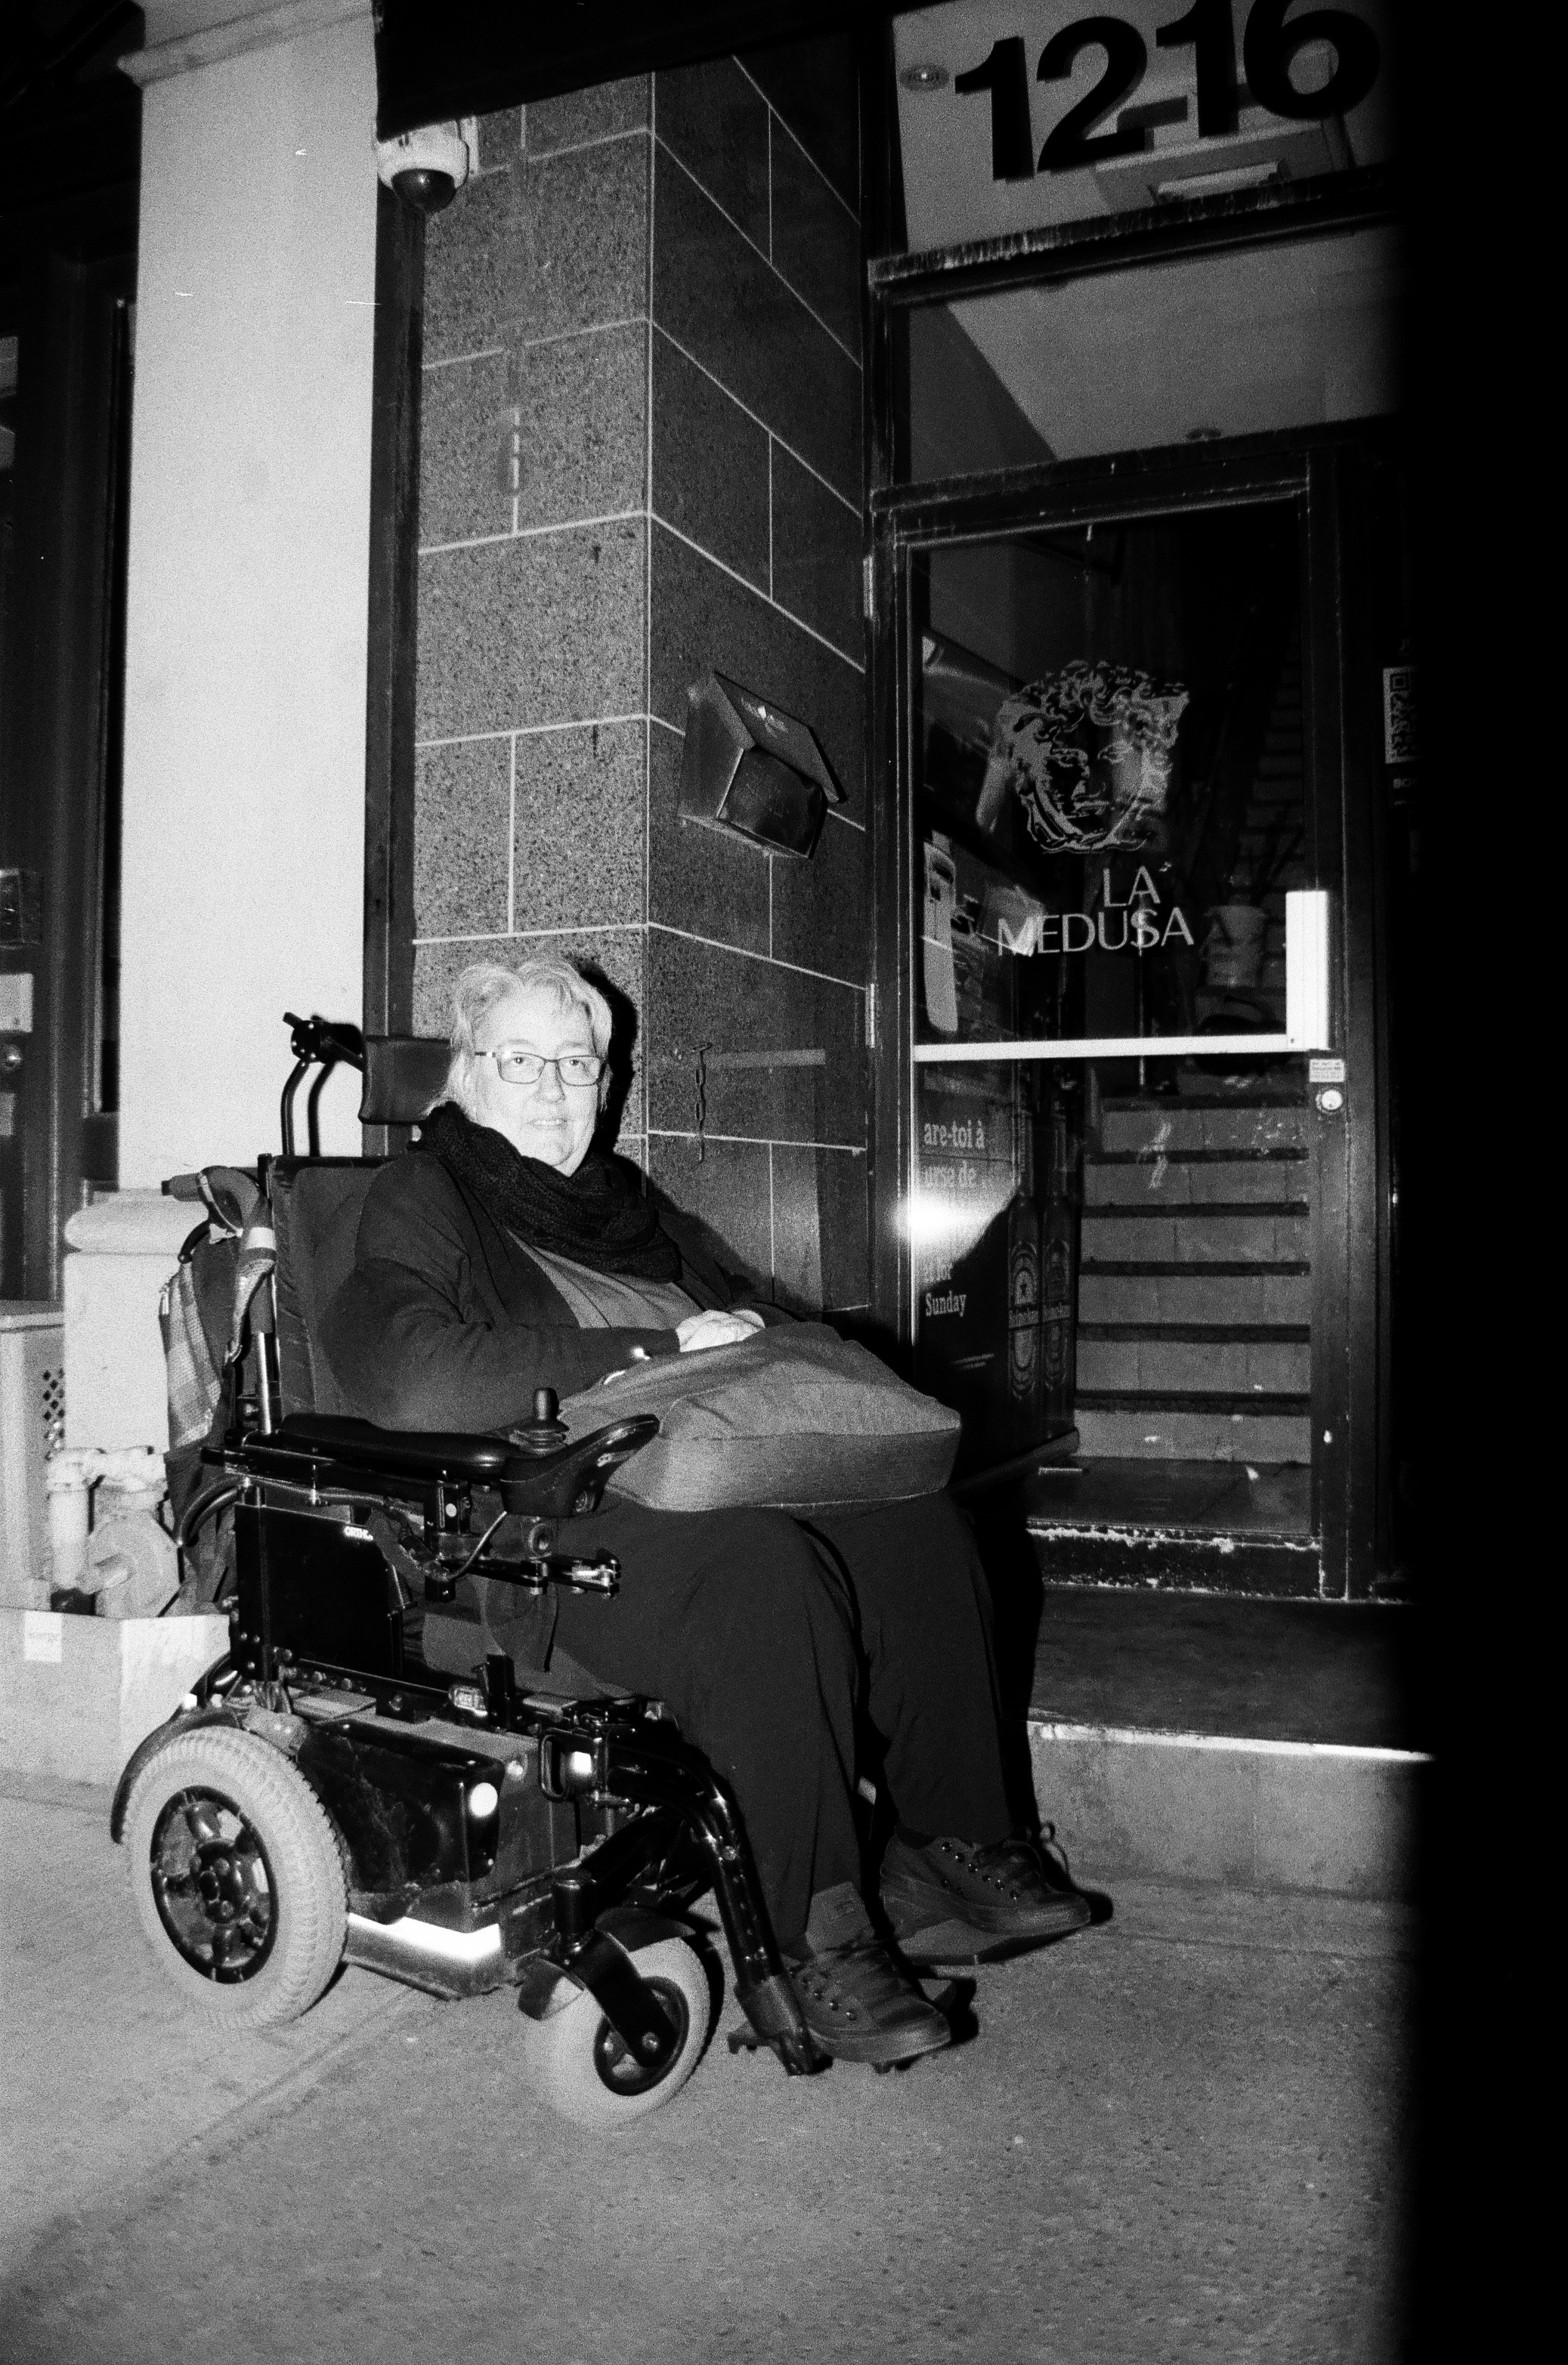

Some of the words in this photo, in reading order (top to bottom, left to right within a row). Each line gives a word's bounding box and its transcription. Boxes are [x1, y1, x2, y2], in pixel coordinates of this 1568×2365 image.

[954, 0, 1381, 182] 1216
[1103, 865, 1161, 908] LA
[997, 906, 1195, 957] MEDUSA
[925, 1289, 966, 1318] Sunday
